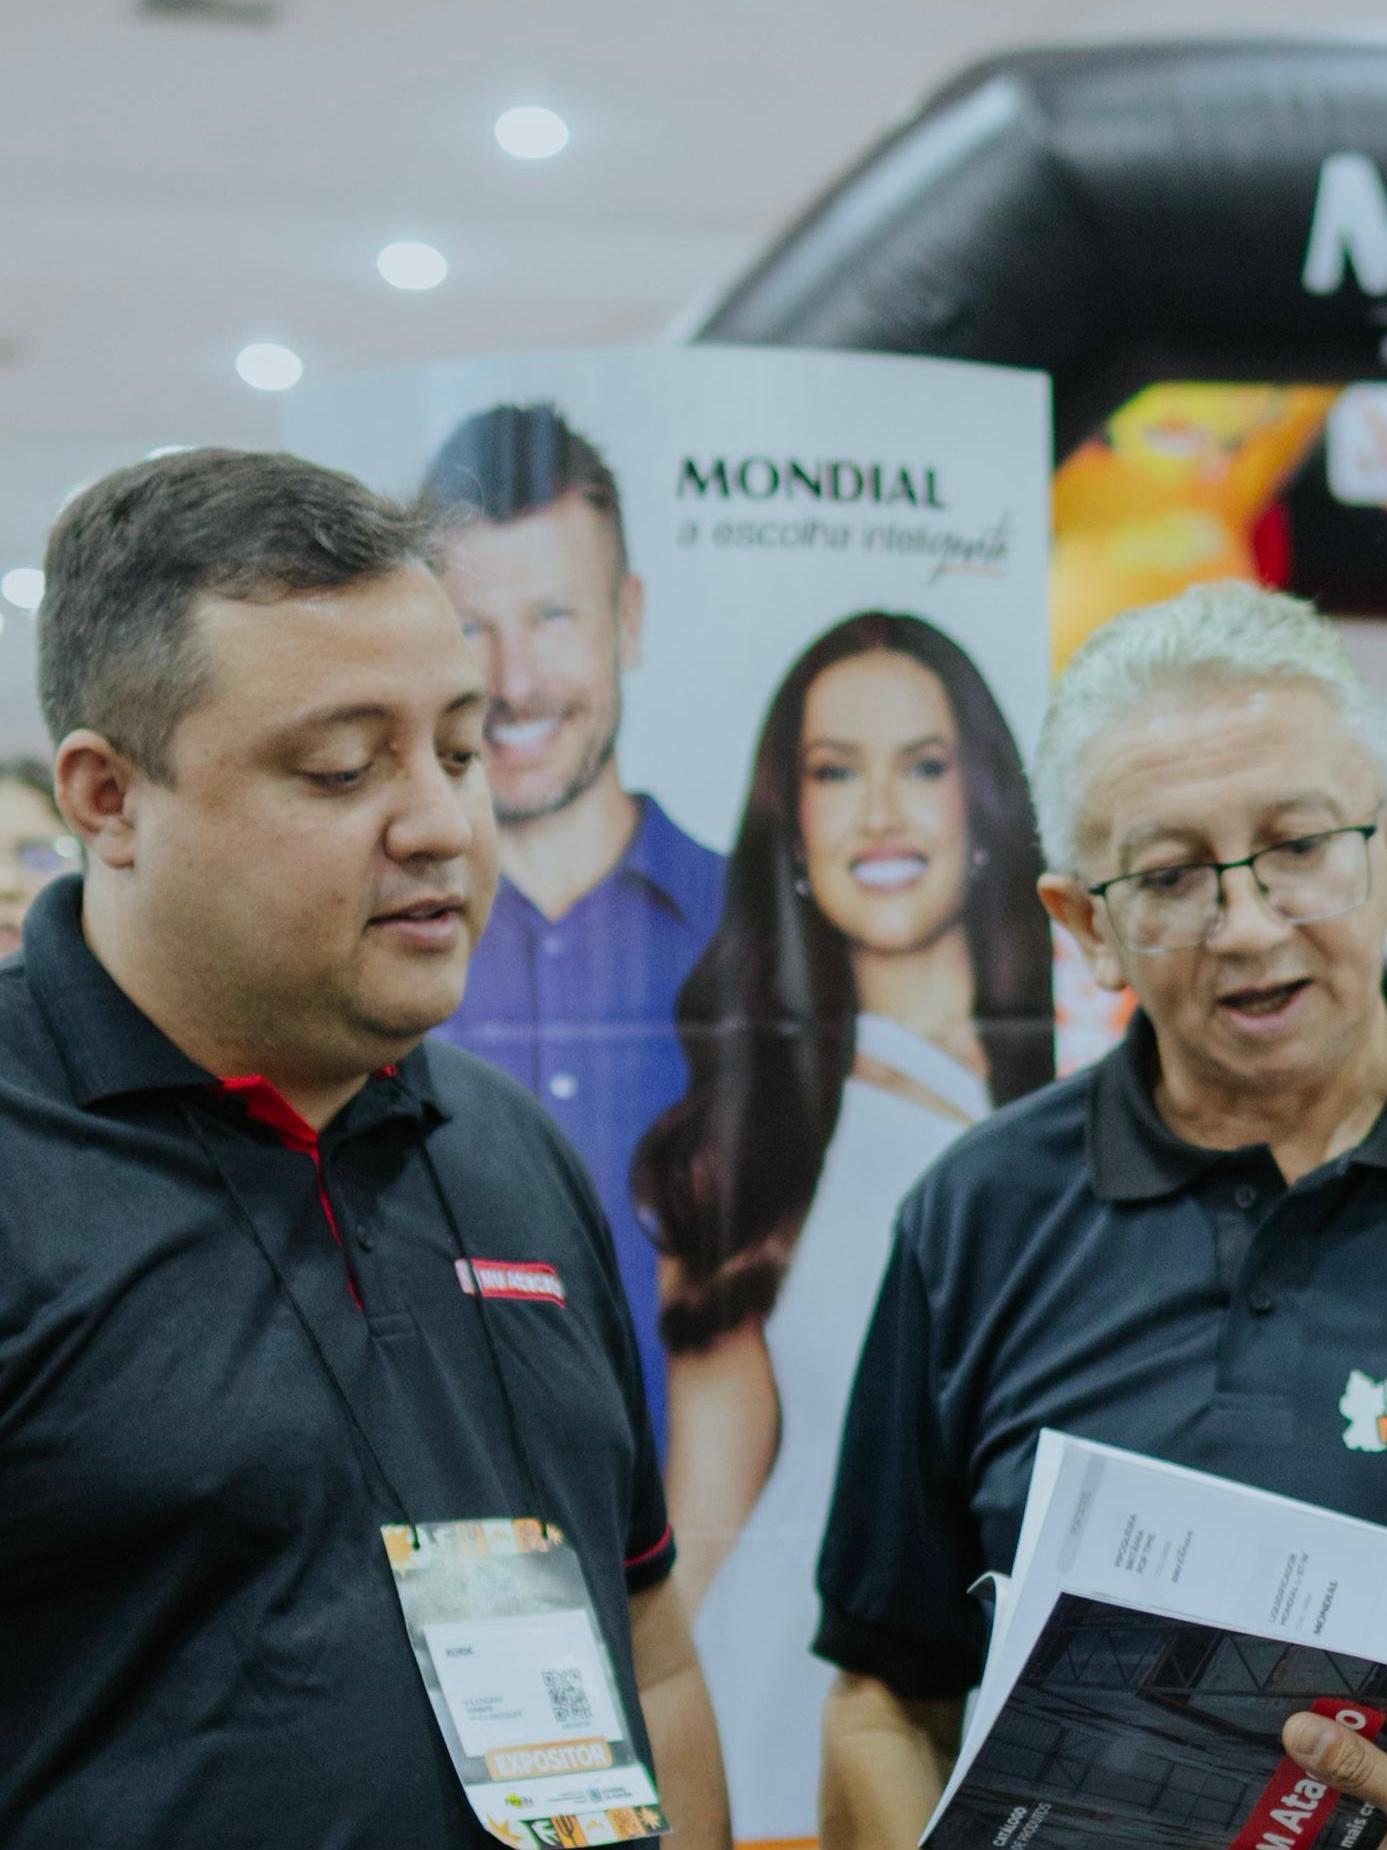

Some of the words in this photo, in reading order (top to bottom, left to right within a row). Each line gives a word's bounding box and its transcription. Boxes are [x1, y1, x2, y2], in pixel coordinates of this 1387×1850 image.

[676, 454, 947, 510] MONDIAL
[676, 519, 698, 548] a
[711, 516, 851, 551] escolha
[1313, 1580, 1338, 1635] MONDIAL
[495, 1741, 608, 1777] EXPOSITOR
[1270, 1709, 1367, 1835] Atao
[993, 1806, 1027, 1847] CATÁLOGO
[1340, 1816, 1367, 1849] mais
